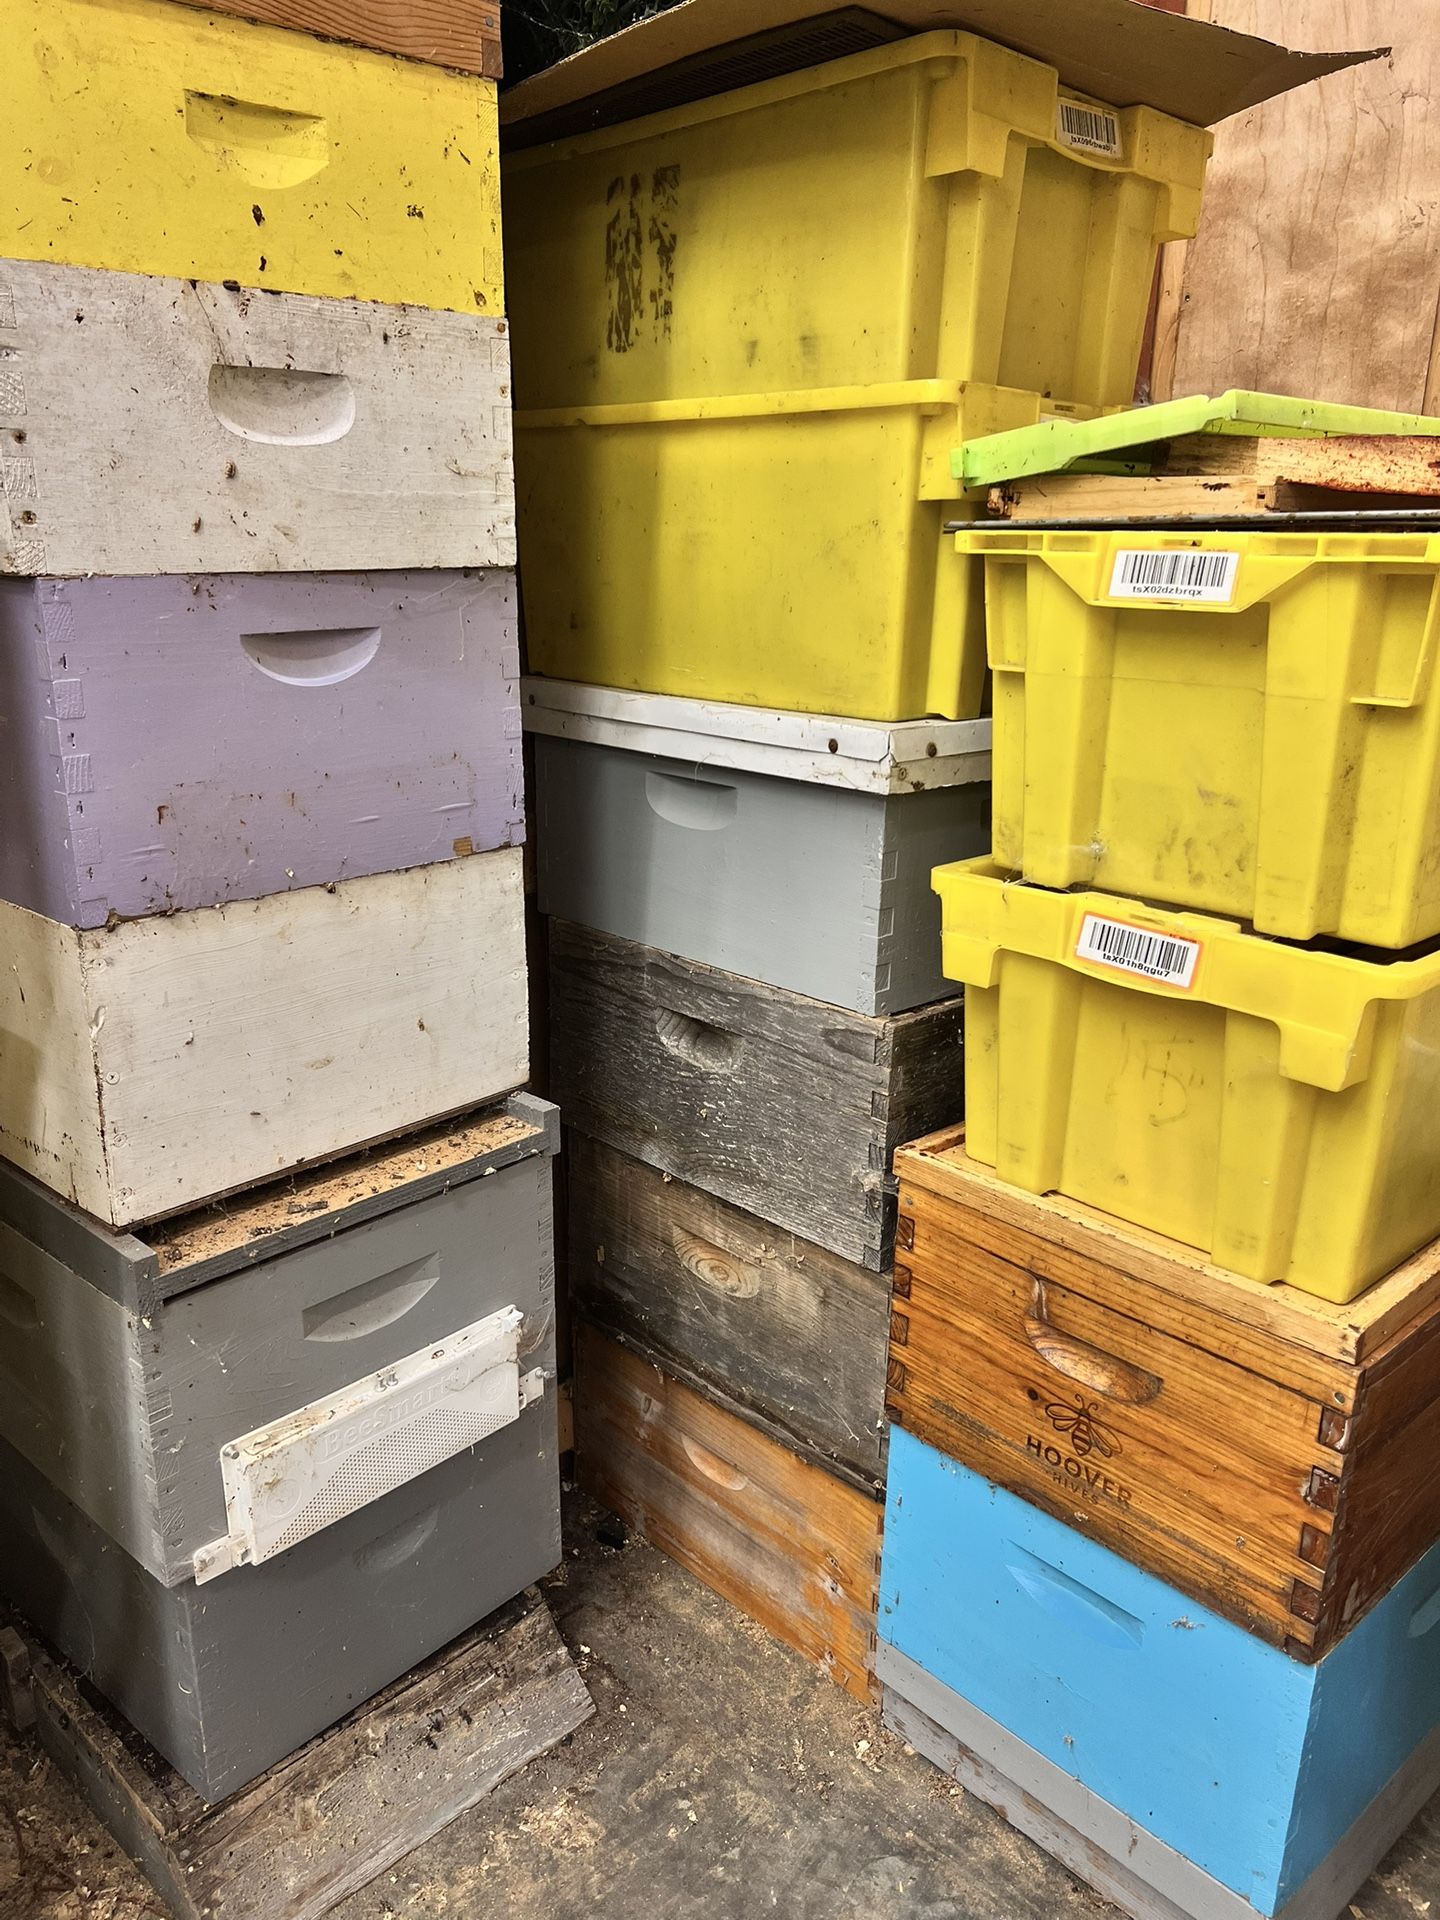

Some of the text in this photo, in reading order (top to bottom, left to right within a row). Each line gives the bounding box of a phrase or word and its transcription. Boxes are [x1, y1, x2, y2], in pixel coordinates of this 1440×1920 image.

[1132, 585, 1203, 598] tsX02dzbrqx
[1102, 953, 1171, 977] tsX01h8qgu7
[1025, 1434, 1132, 1507] HOOVER
[1052, 1473, 1099, 1505] HIVES
